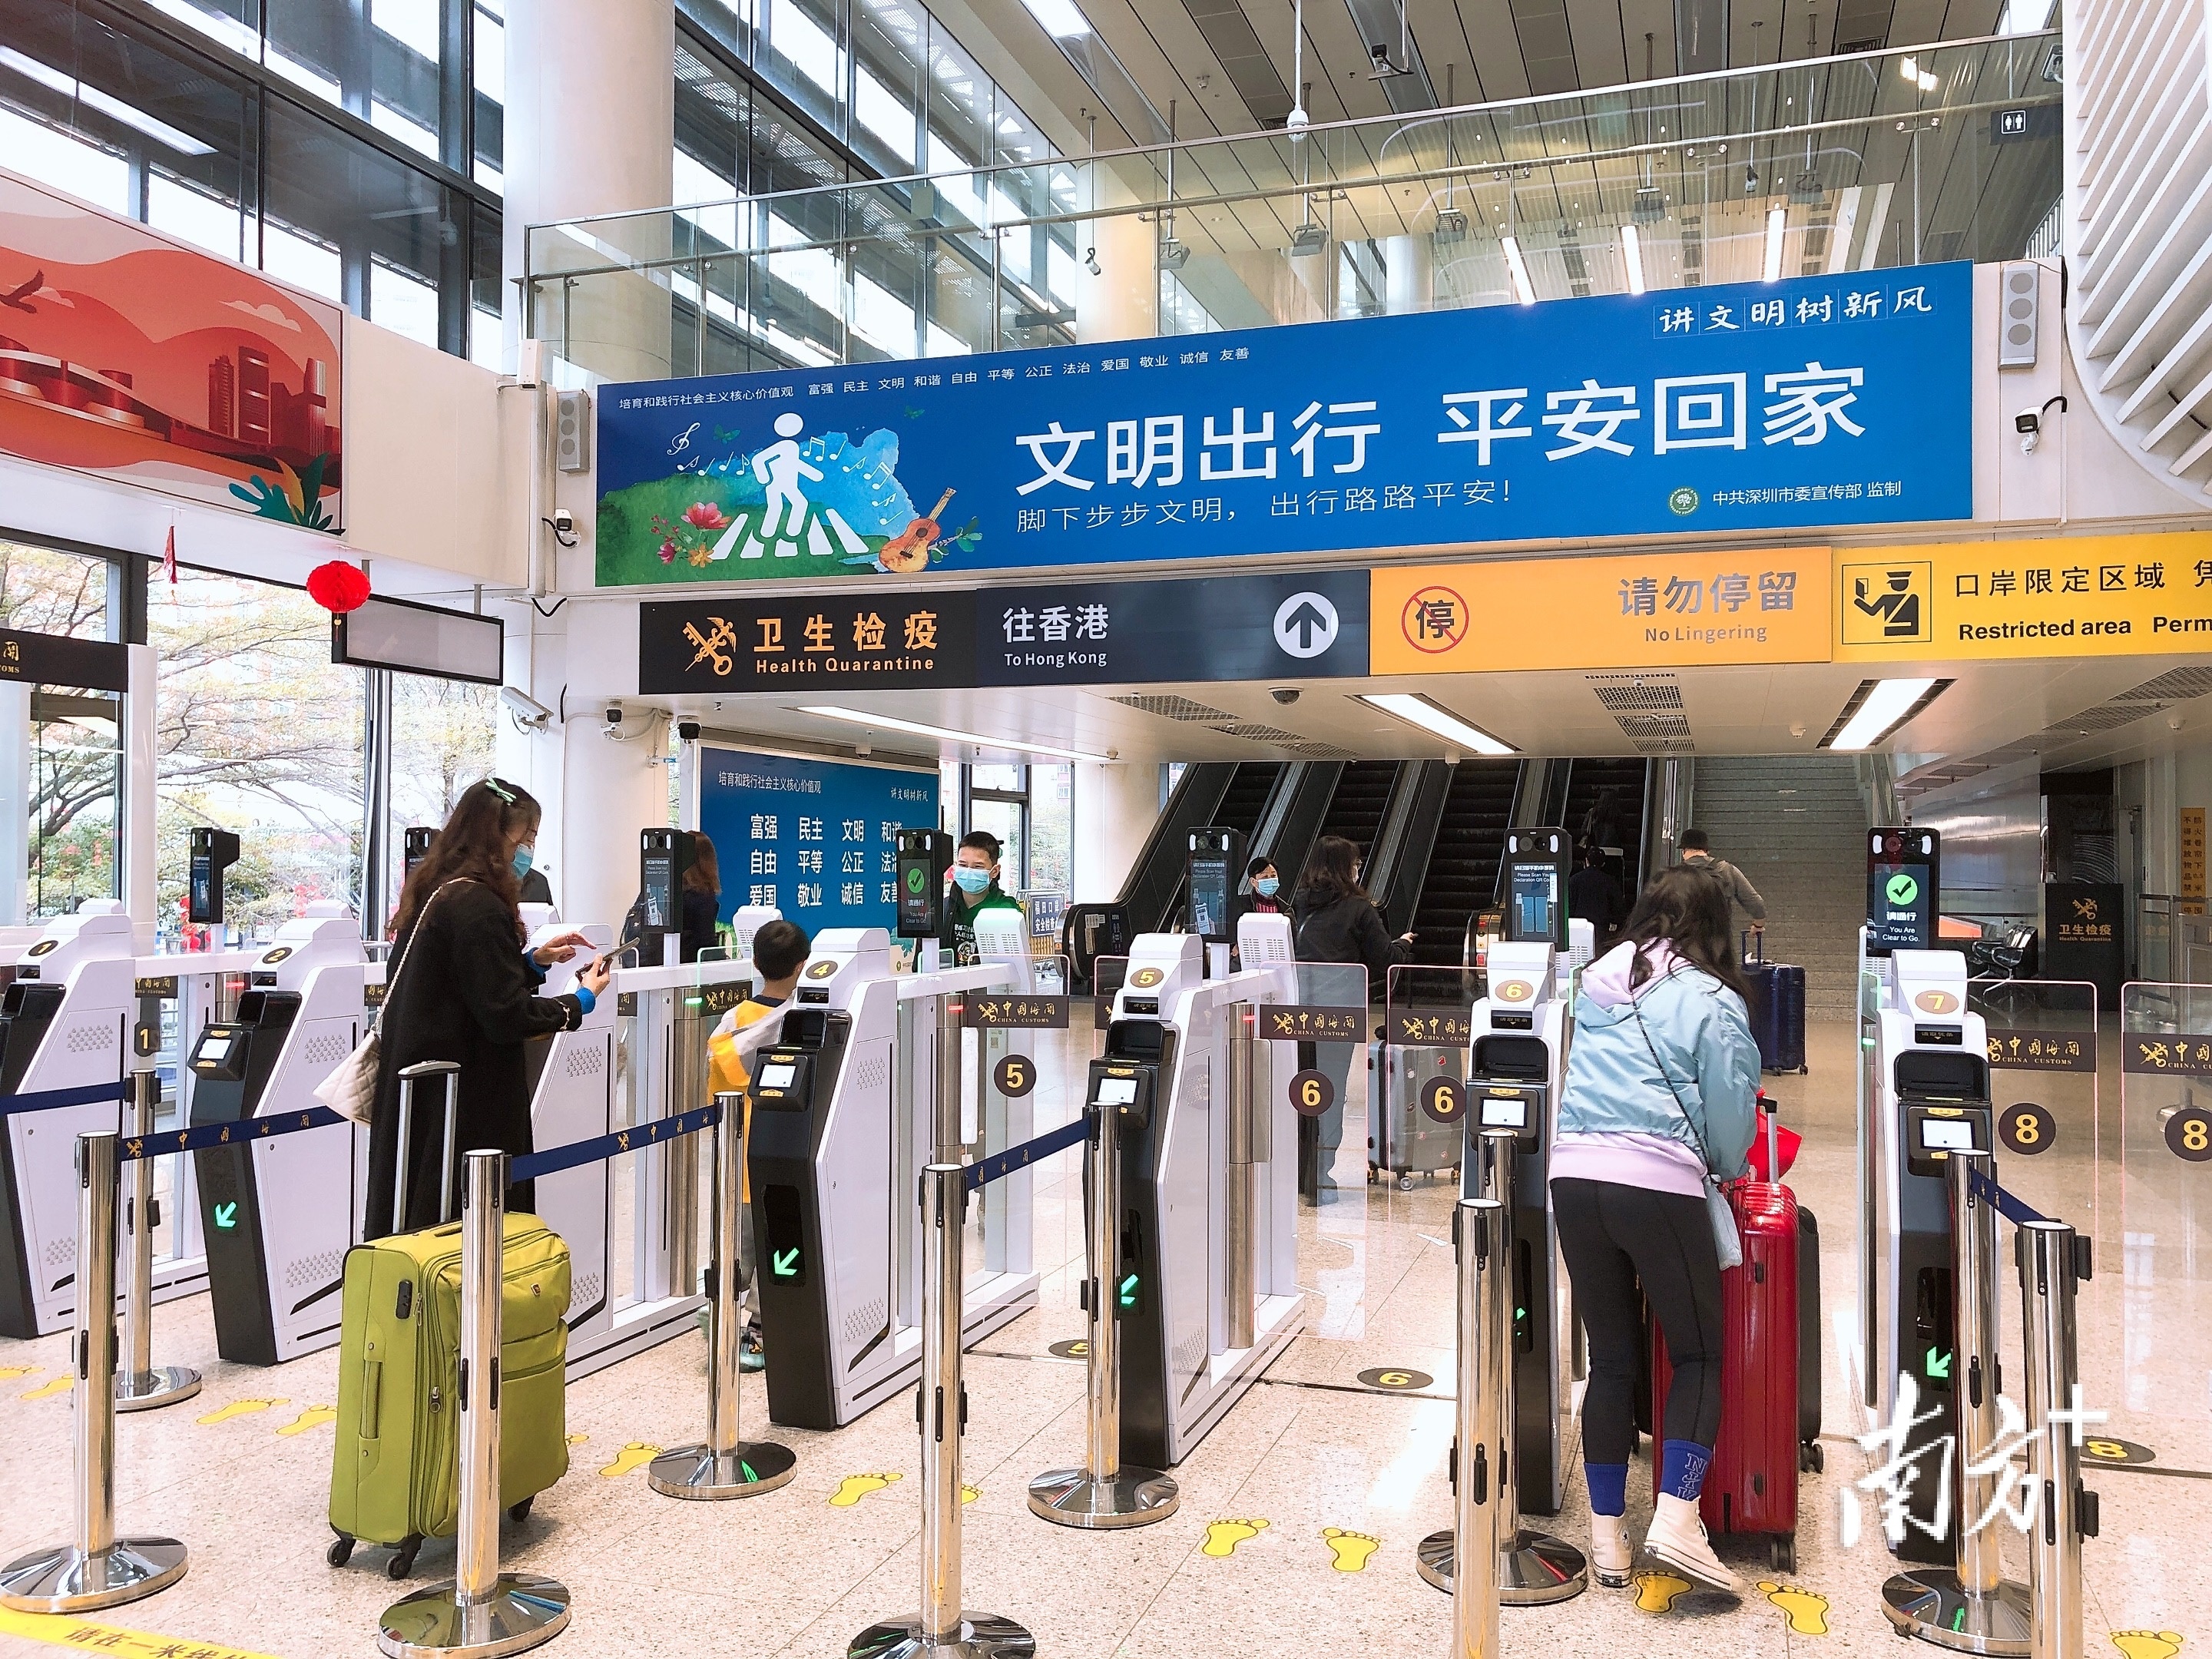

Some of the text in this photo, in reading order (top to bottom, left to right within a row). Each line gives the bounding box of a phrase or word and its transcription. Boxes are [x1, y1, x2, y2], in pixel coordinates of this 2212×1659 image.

[1659, 285, 1933, 334] 讲文明树新风
[619, 346, 1250, 409] 培育和践行社会主义核心价值观 富强 民主 文明 和谐 自由 平等 公正 法治 爱国 敬业 诚信 友善
[1015, 361, 1866, 497] 文明出行 平安回家
[1713, 483, 1863, 506] 中共深圳市委宣传部
[1866, 480, 1902, 498] 监制
[1955, 561, 2166, 598] 口岸限定区域
[1618, 571, 1797, 617] 请勿停留
[754, 610, 939, 652] 卫生检疫
[1002, 604, 1109, 643] 往香港
[1415, 598, 1455, 641] 停
[1959, 618, 2075, 641] Restricted
[2081, 621, 2131, 636] area
[1645, 624, 1767, 644] No Lingering
[0, 664, 20, 674] OMS
[757, 656, 934, 674] Health Quarantine
[1004, 651, 1107, 668] To Hong Kong
[718, 770, 821, 794] 培育和践行社会主义核心价值观
[890, 786, 929, 803] 讲文明树新风
[750, 813, 778, 840] 富强
[799, 816, 823, 841] 民主
[842, 819, 864, 843] 文明
[750, 849, 777, 875] 自由
[797, 849, 823, 875] 平等
[841, 850, 864, 874] 公正
[749, 884, 777, 909] 爱国
[797, 882, 823, 908] 敬业
[841, 882, 864, 906] 诚信
[1035, 916, 1059, 932] 安全检查
[2058, 923, 2112, 935] 卫生检疫
[38, 942, 52, 954] 1
[266, 949, 287, 961] 2
[813, 963, 830, 976] 4
[1137, 970, 1155, 985] 5
[1505, 984, 1523, 998] 6
[1926, 994, 1945, 1010] 7
[140, 1028, 149, 1049] 1
[1006, 1063, 1024, 1088] 5
[1302, 1079, 1321, 1107] 6
[1434, 1086, 1454, 1114] 6
[2015, 1114, 2039, 1144] 8
[2183, 1119, 2208, 1151] 8
[1378, 1372, 1412, 1386] 6
[2085, 1440, 2129, 1459] 8
